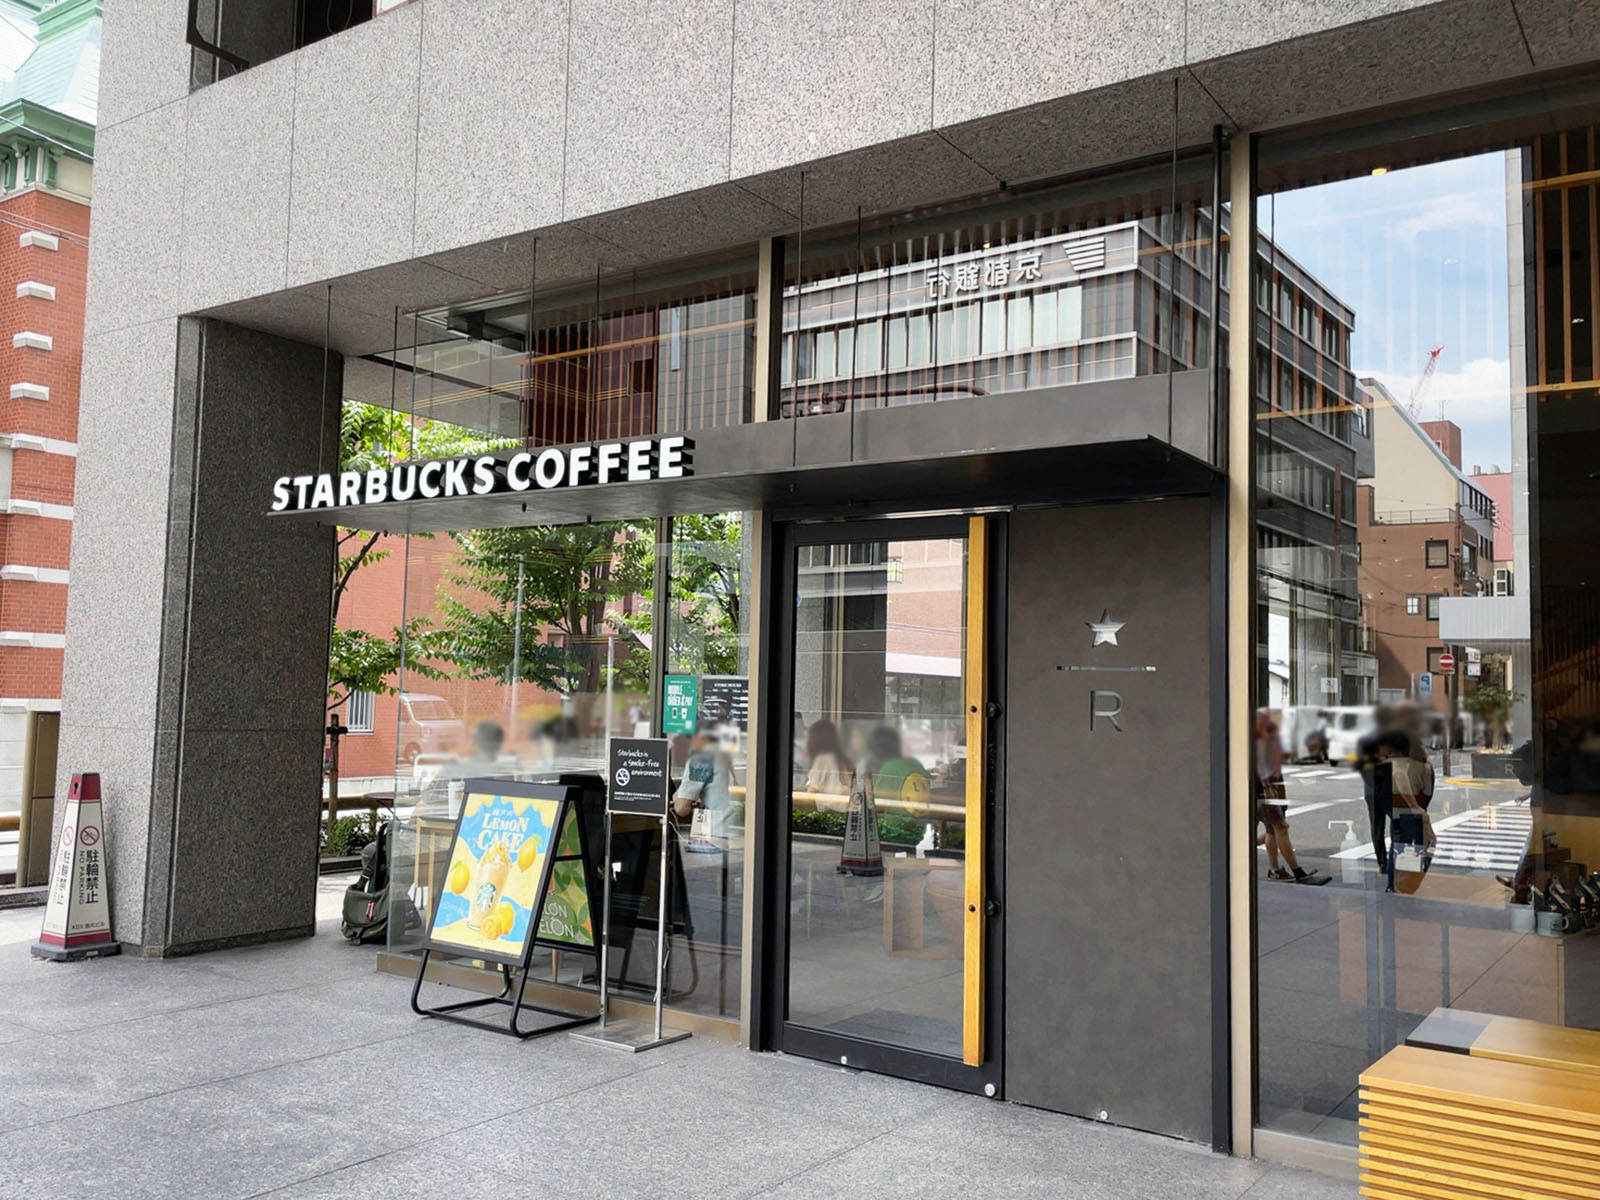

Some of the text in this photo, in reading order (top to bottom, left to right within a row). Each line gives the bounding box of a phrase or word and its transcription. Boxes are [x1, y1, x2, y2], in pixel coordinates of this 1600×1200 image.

[271, 436, 688, 512] STARBUCKS COFFEE
[1089, 690, 1123, 732] R
[481, 812, 530, 833] LEMON
[477, 829, 526, 854] CAKE
[86, 849, 99, 905] 駐輪禁止
[543, 902, 568, 919] LON
[539, 917, 576, 938] ELON
